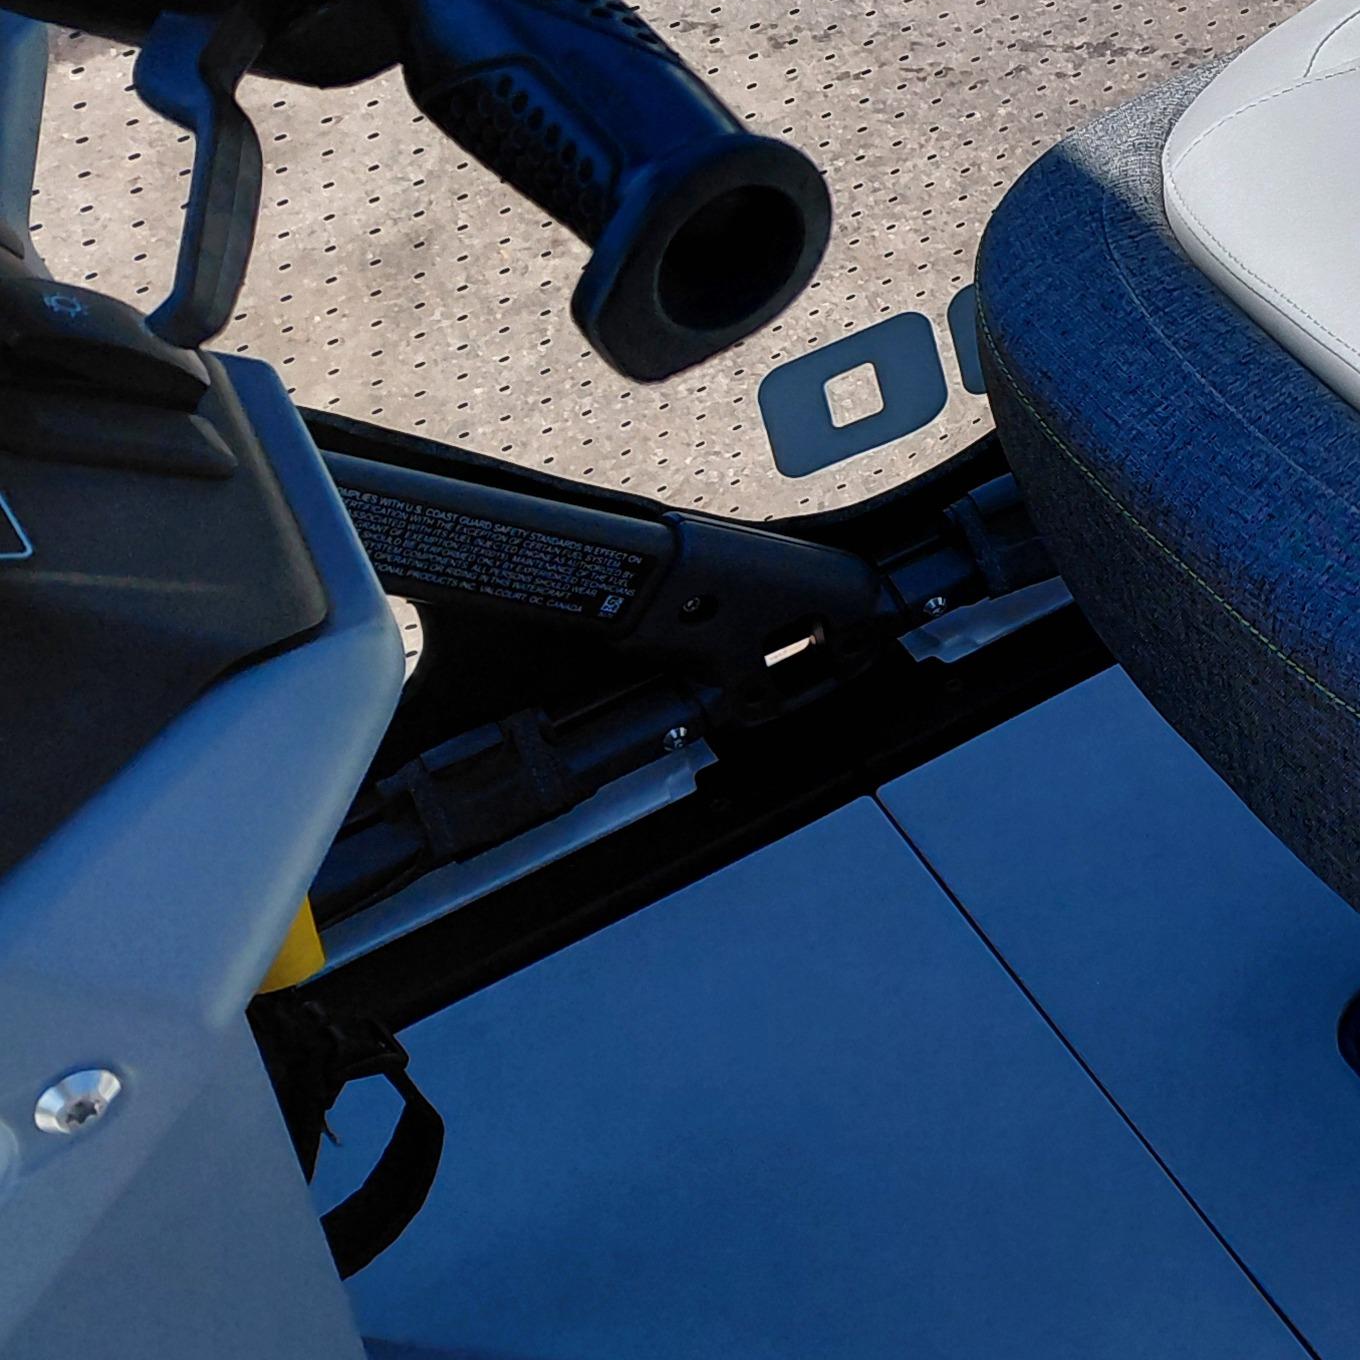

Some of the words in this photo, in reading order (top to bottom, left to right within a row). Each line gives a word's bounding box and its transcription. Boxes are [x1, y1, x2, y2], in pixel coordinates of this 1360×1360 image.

[380, 497, 405, 508] WITH
[425, 507, 458, 521] COAST
[459, 515, 492, 529] GUARD
[494, 523, 528, 537] SAFETY
[530, 532, 583, 550] STANDARDS
[594, 547, 627, 560] EFFECT
[411, 514, 434, 525] WITH
[436, 520, 454, 529] THE
[456, 524, 508, 541] EXCEPTION
